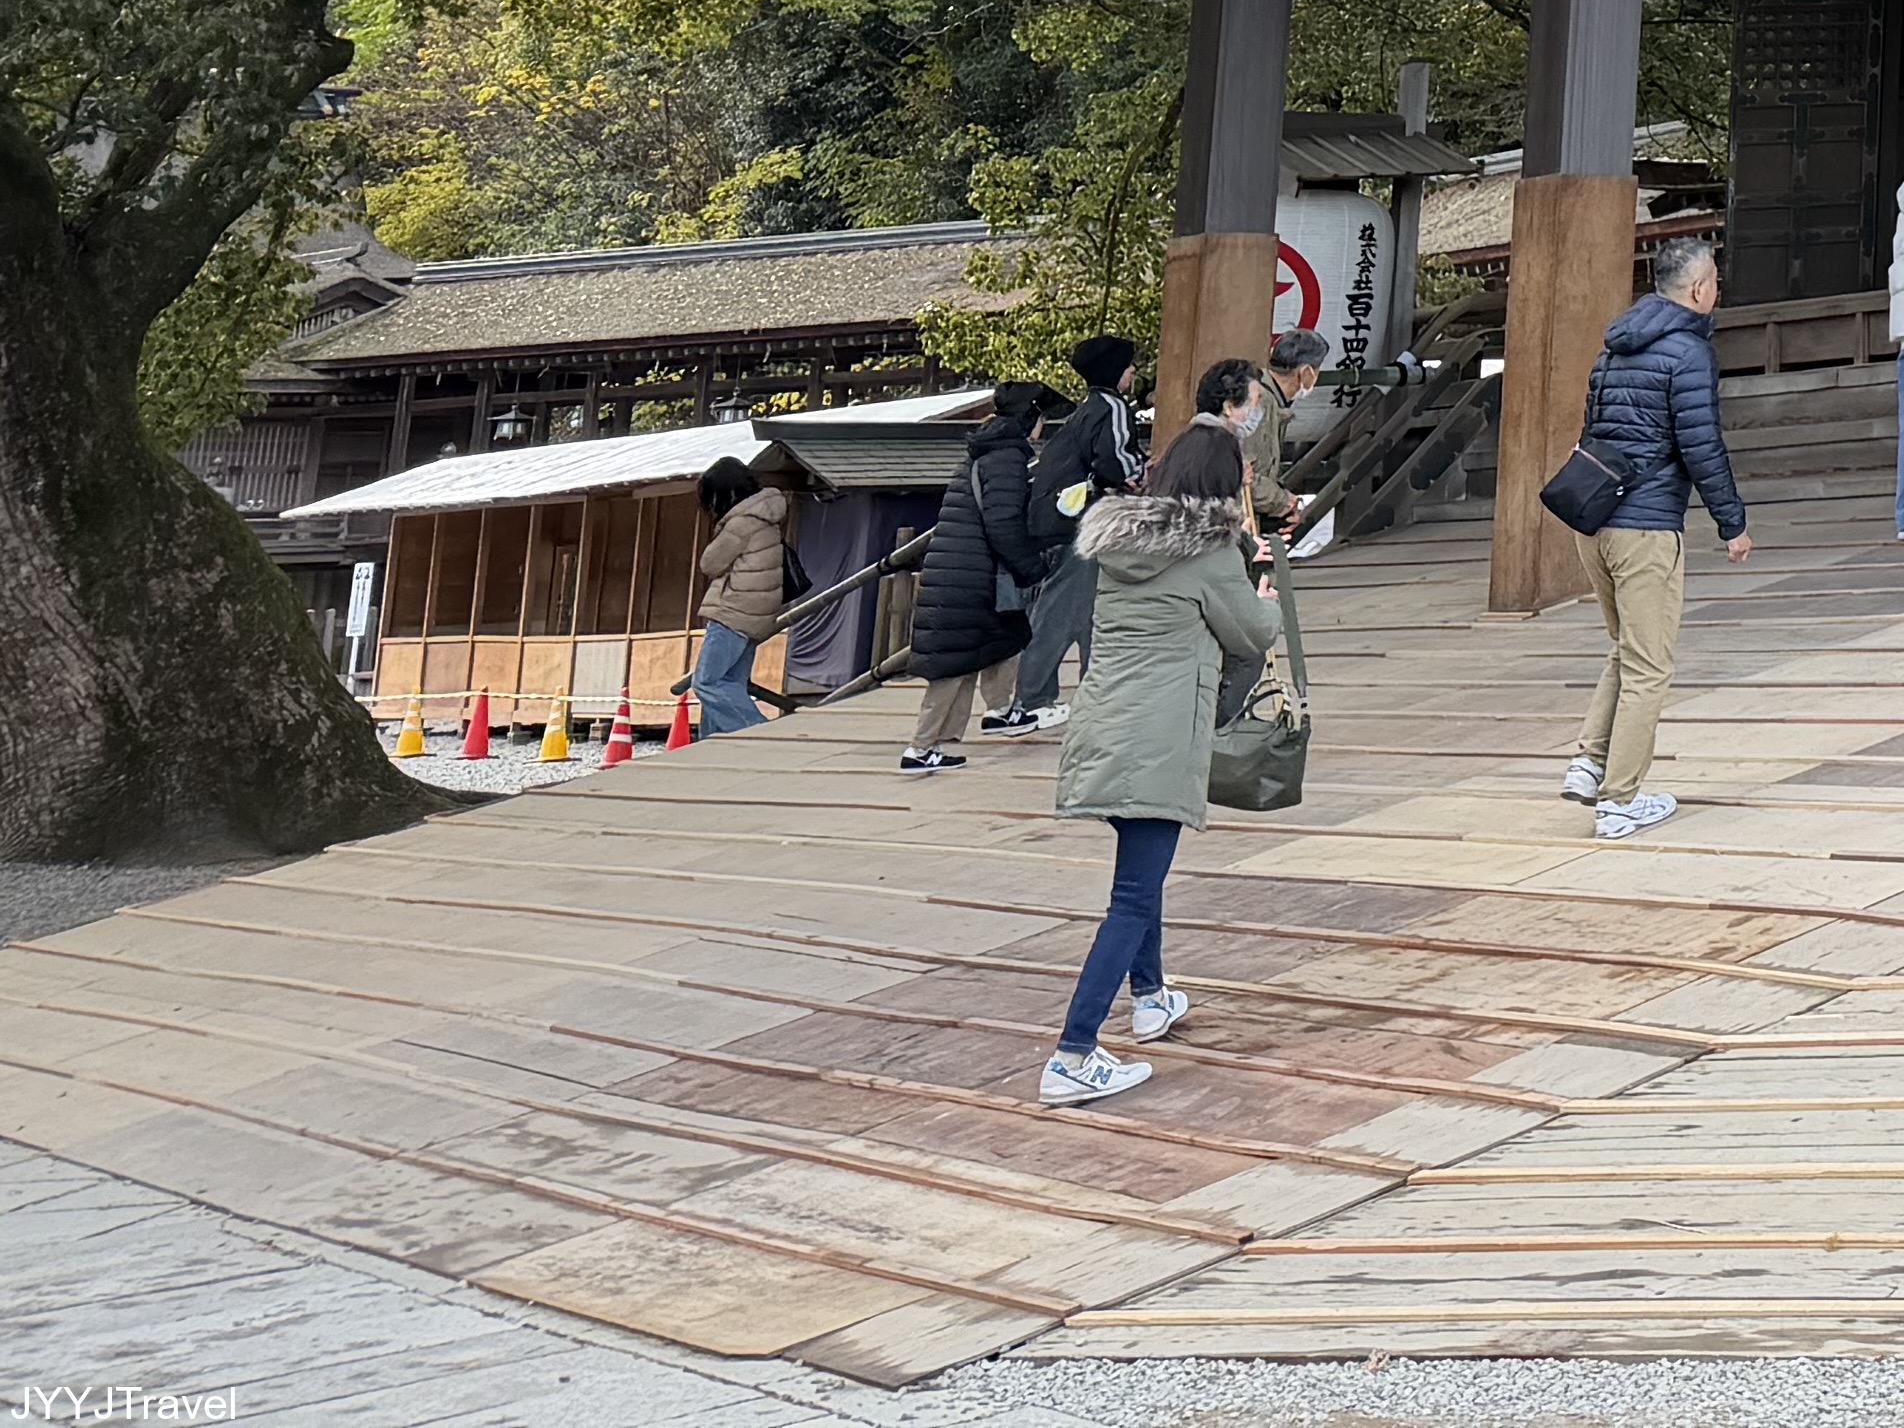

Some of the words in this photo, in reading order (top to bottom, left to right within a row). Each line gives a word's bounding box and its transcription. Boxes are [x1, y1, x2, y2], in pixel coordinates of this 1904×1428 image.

[1009, 711, 1022, 723] N
[926, 753, 943, 765] N
[1090, 1065, 1112, 1085] N
